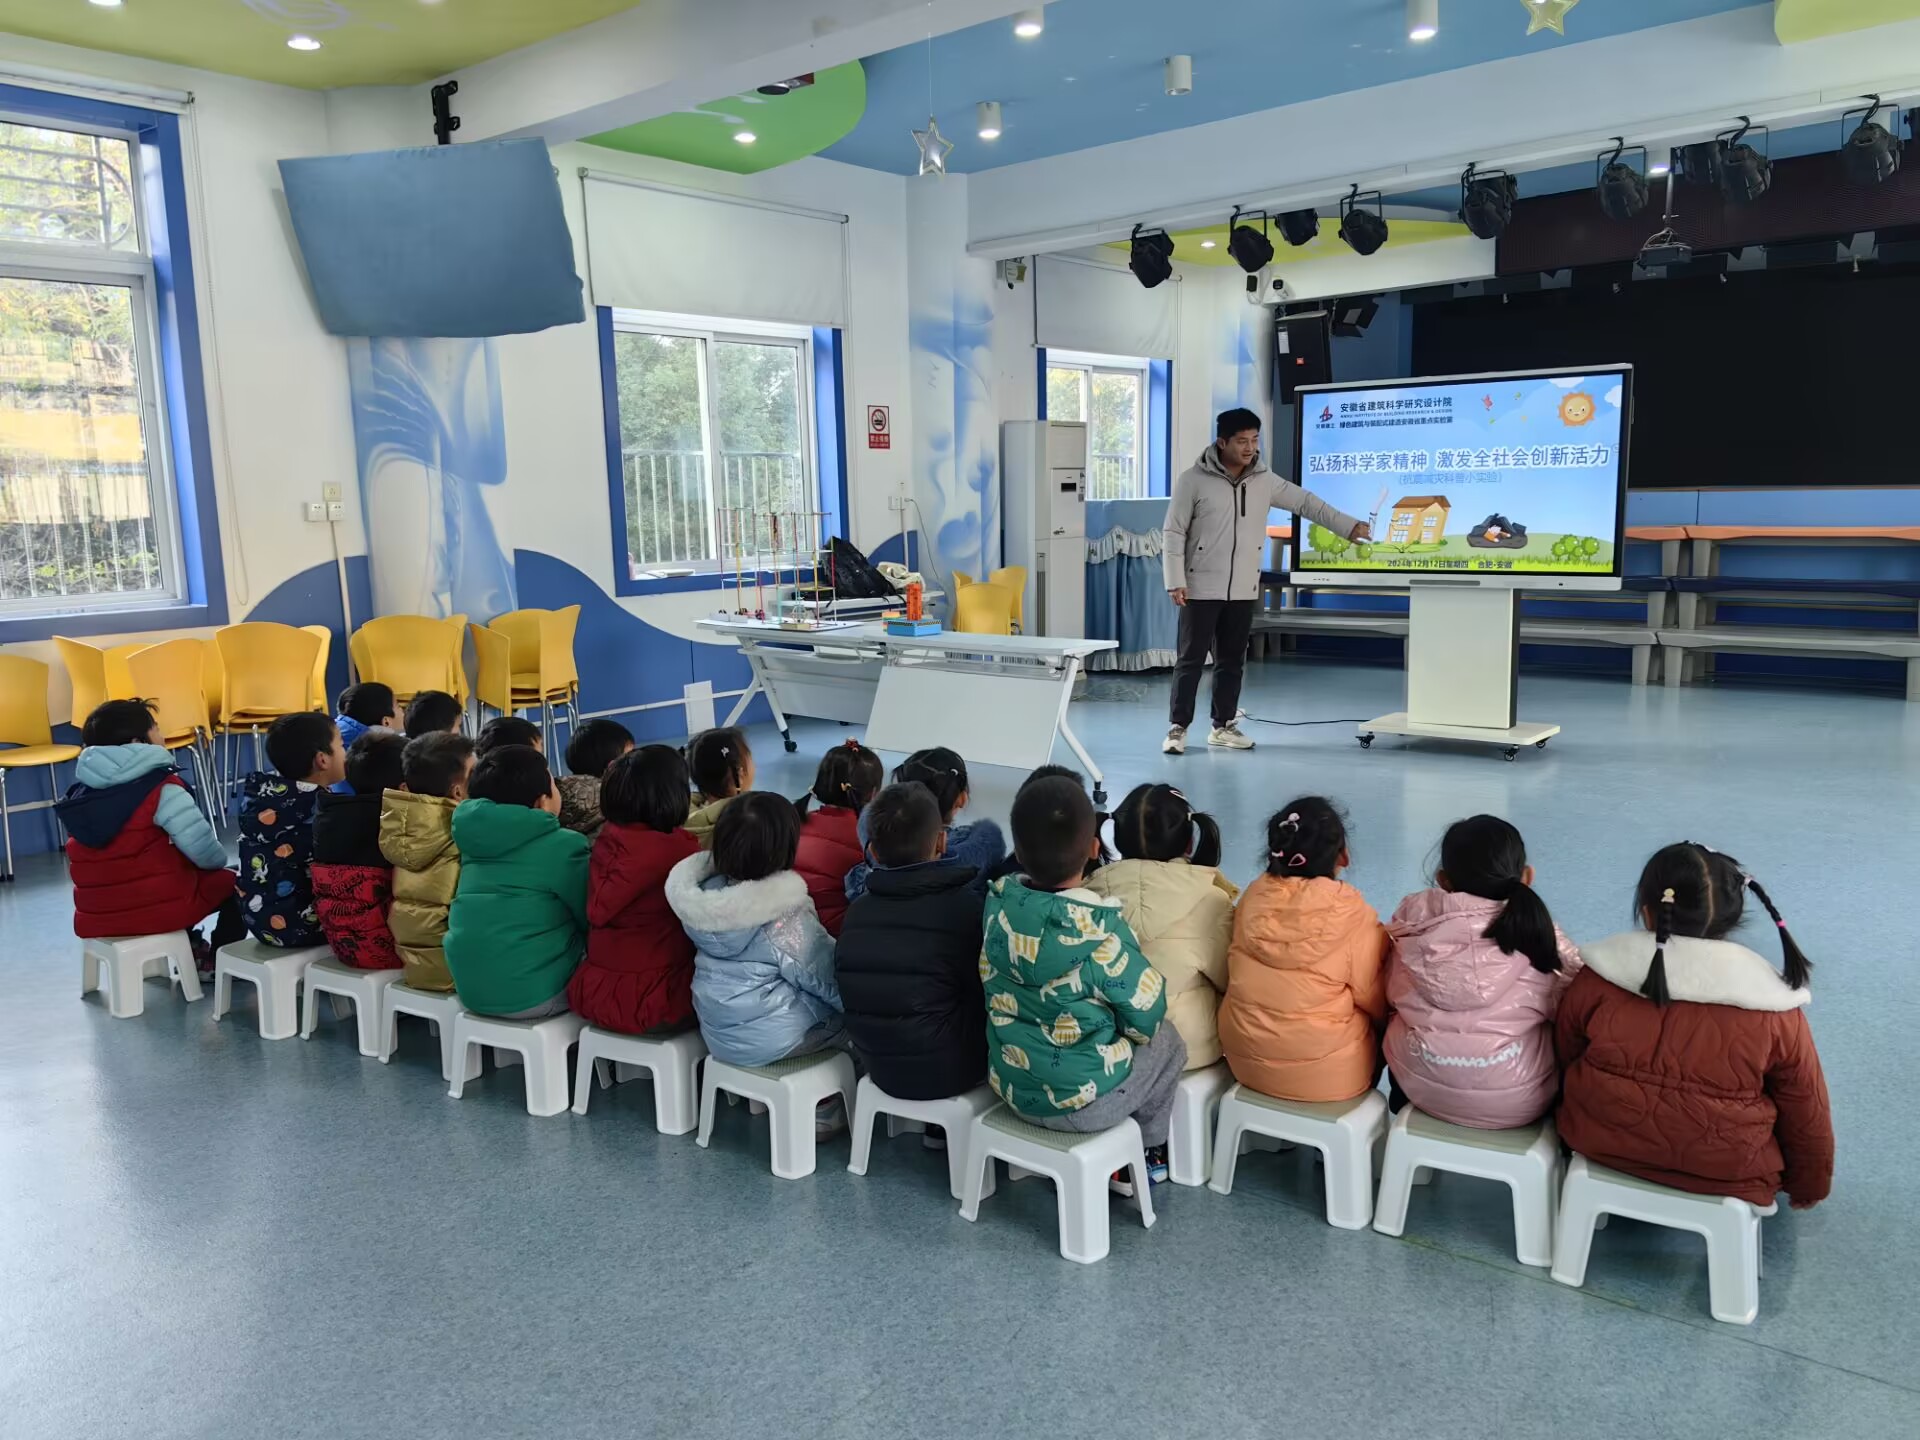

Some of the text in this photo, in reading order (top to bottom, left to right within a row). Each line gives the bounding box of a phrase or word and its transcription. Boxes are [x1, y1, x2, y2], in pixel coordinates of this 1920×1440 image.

[1340, 397, 1452, 412] 安徽省建筑科学研究设计院
[1309, 445, 1610, 473] 弘扬科学家精神 激发全社会创新活力
[1106, 979, 1126, 989] cat
